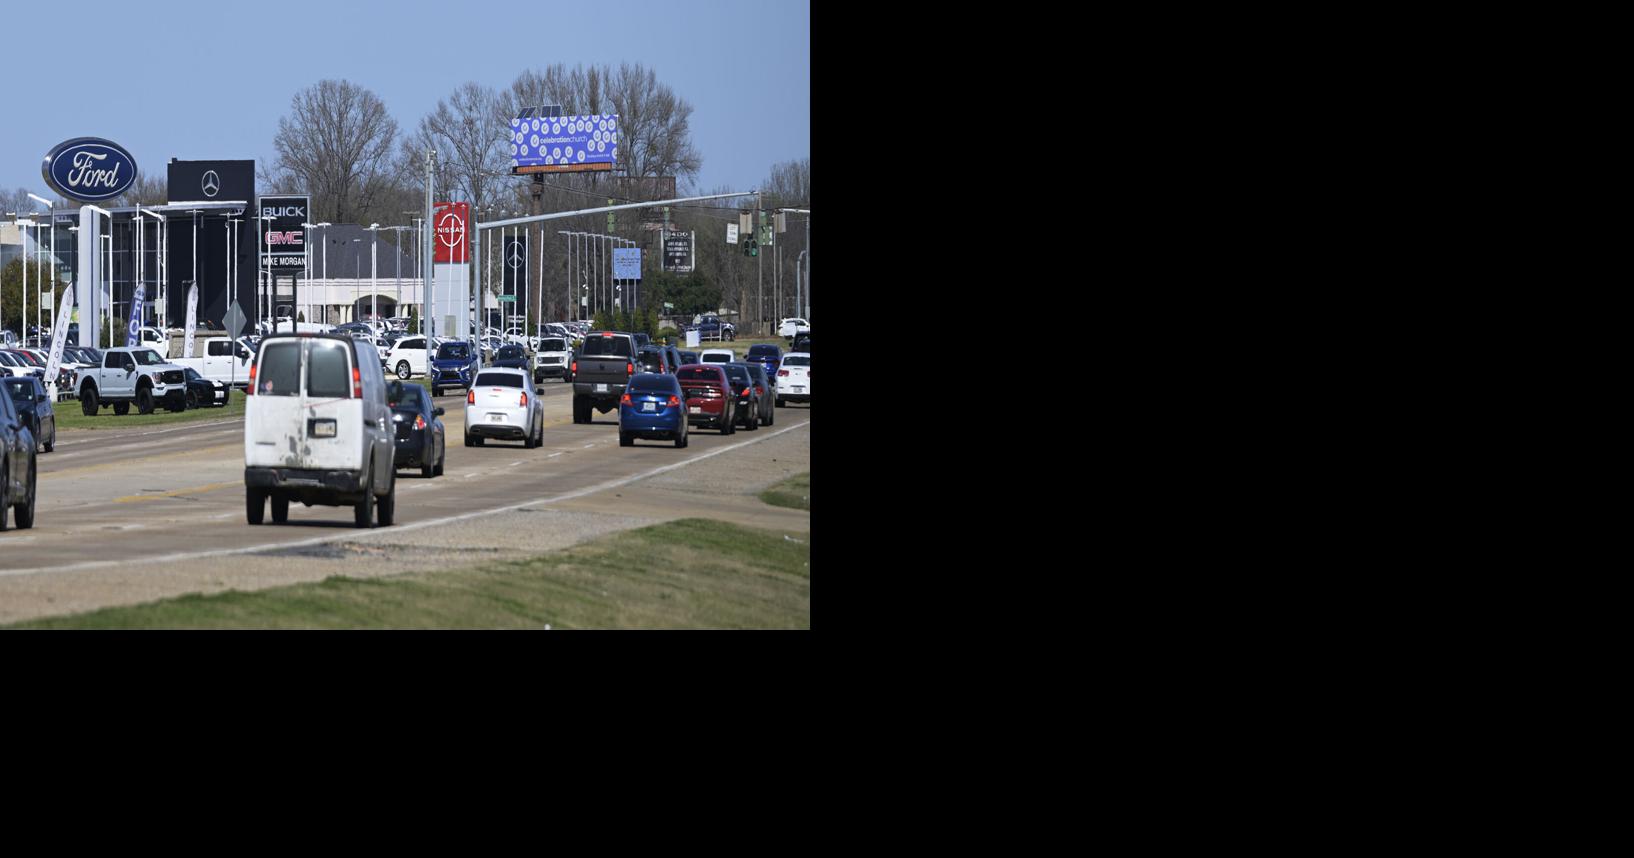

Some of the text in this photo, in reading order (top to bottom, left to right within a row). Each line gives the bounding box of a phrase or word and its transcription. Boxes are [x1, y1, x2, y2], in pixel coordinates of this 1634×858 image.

[68, 151, 120, 188] Ford
[263, 206, 305, 217] BUICK
[265, 231, 304, 245] GMC
[262, 257, 307, 266] MKE MORGAN
[128, 300, 142, 347] FOR
[49, 311, 68, 379] LINCOLN
